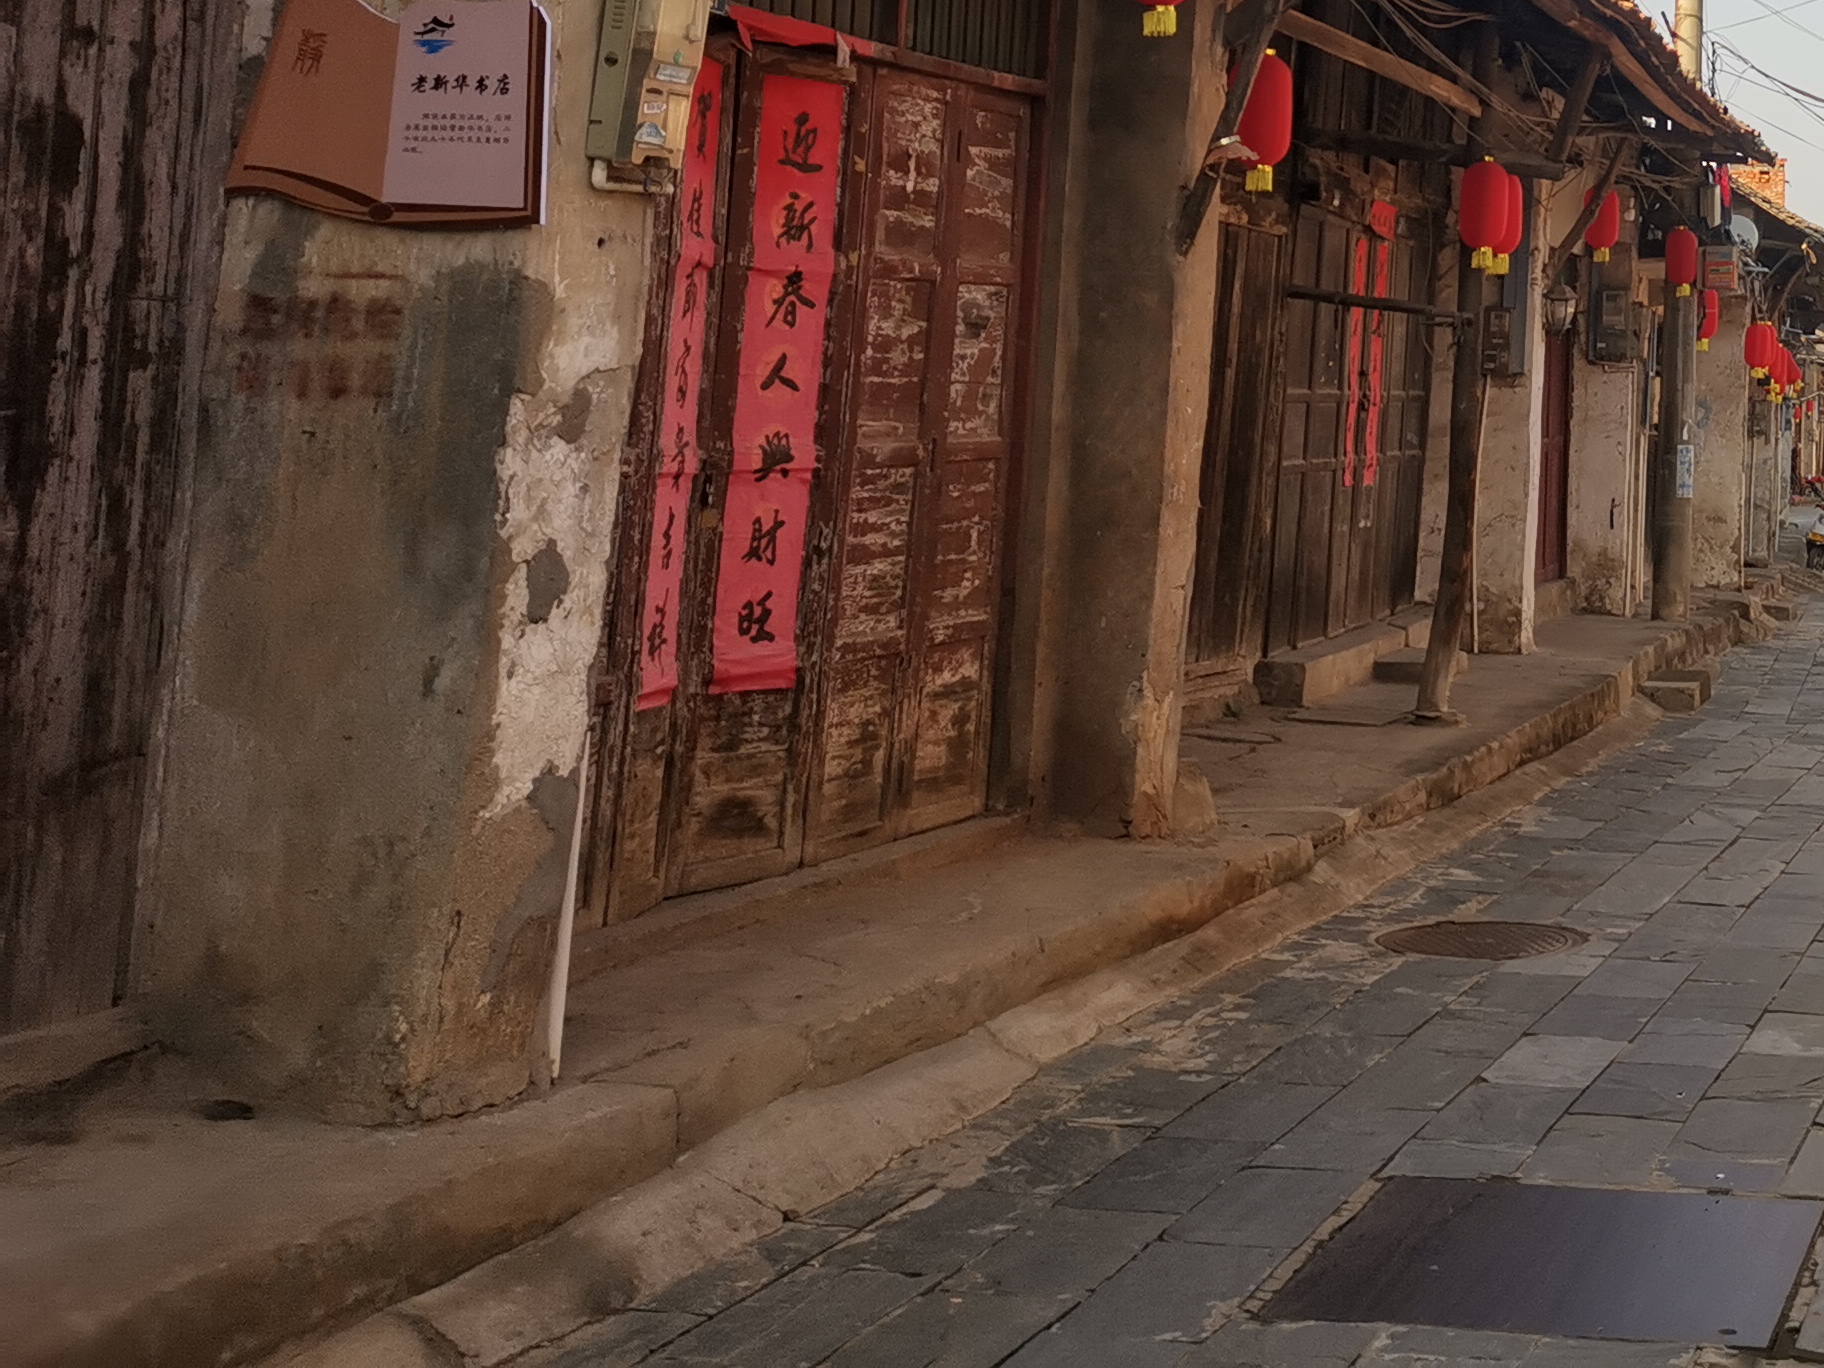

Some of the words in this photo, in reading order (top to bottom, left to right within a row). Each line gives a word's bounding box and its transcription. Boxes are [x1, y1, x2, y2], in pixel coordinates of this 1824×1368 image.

[411, 73, 511, 96] 老新华书店
